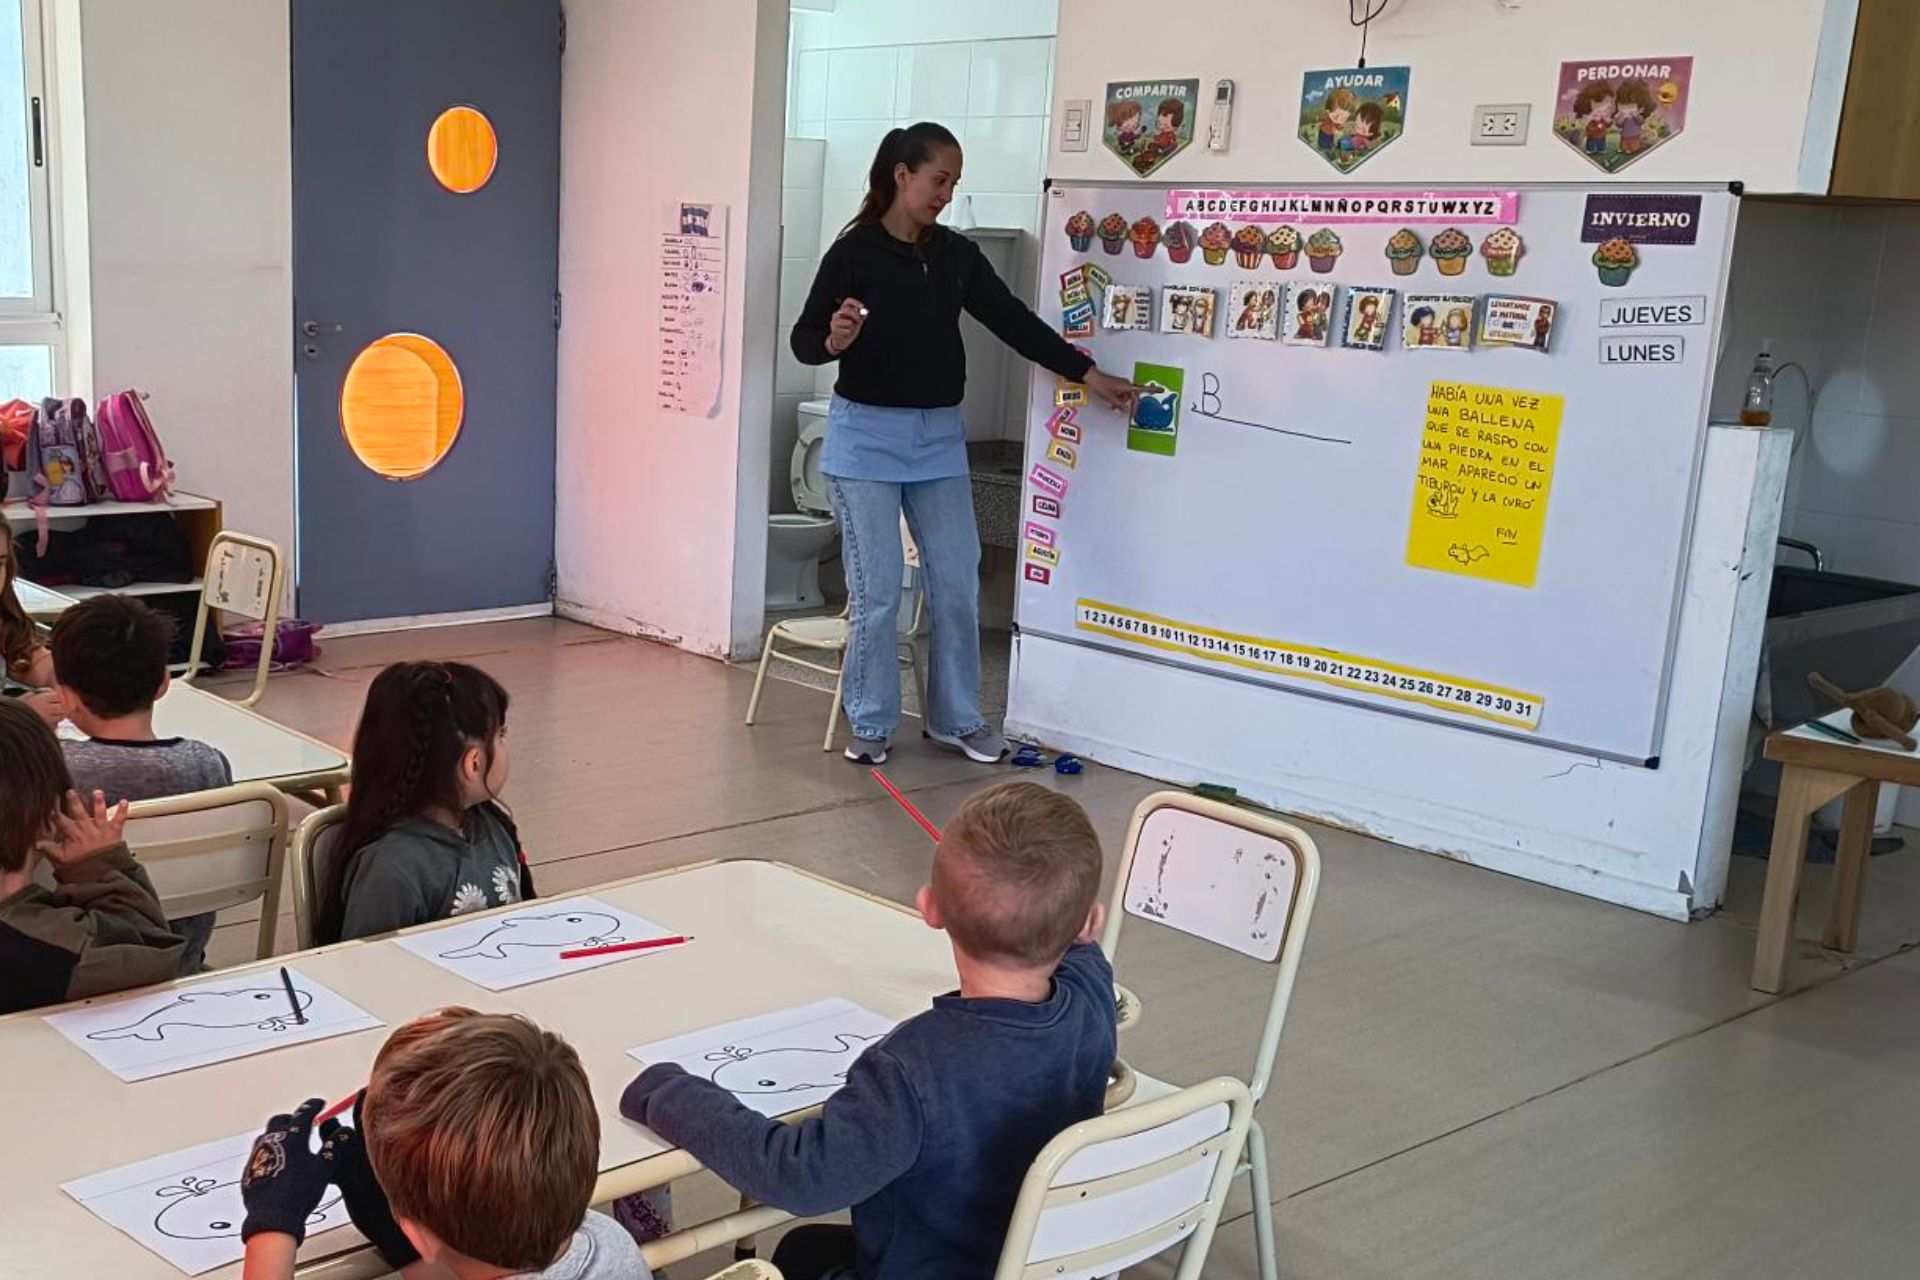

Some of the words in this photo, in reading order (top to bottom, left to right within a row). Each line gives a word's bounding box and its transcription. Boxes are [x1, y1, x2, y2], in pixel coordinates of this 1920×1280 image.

[1324, 74, 1384, 90] AYUDAR
[1577, 64, 1671, 82] PERDONAR
[1115, 85, 1187, 100] COMPARTIR
[1591, 212, 1691, 228] INVIERNO
[1611, 305, 1692, 324] JUEVES
[1607, 344, 1675, 362] LUNES
[1431, 385, 1467, 403] HABÍA
[1475, 393, 1504, 406] UNA
[1512, 396, 1540, 410] VEZ
[1427, 405, 1450, 417] UNA
[1459, 408, 1535, 432] BALLENA
[1426, 422, 1449, 433] QUE
[1524, 442, 1549, 454] CON
[1423, 440, 1442, 452] UNA
[1449, 443, 1493, 461] PIEDRA
[1501, 455, 1520, 467] EN
[1529, 461, 1545, 472] EL
[1421, 457, 1448, 470] MAR
[1524, 480, 1542, 490] UN
[1471, 488, 1479, 502] Y
[1482, 493, 1497, 504] LA
[1495, 527, 1518, 539] FIN
[1160, 627, 1171, 639] 10
[1173, 630, 1184, 642] 11
[1187, 633, 1199, 646] 12
[1202, 637, 1214, 649] 13
[1217, 640, 1230, 652] 14
[1232, 643, 1246, 656] 15
[1248, 647, 1260, 659] 16
[1263, 650, 1277, 661] 17
[1280, 653, 1294, 665] 18
[1297, 655, 1310, 668] 19
[1314, 659, 1327, 672] 20
[1330, 663, 1343, 676] 21
[1347, 666, 1362, 680] 22
[1364, 669, 1379, 683] 23
[1382, 673, 1396, 687] 24
[1399, 677, 1415, 691] 25
[1418, 681, 1434, 694] 26
[1436, 684, 1453, 698] 27
[1455, 688, 1472, 703] 28
[1475, 692, 1492, 707] 29
[1495, 697, 1512, 712] 30
[1515, 702, 1531, 716] 31
